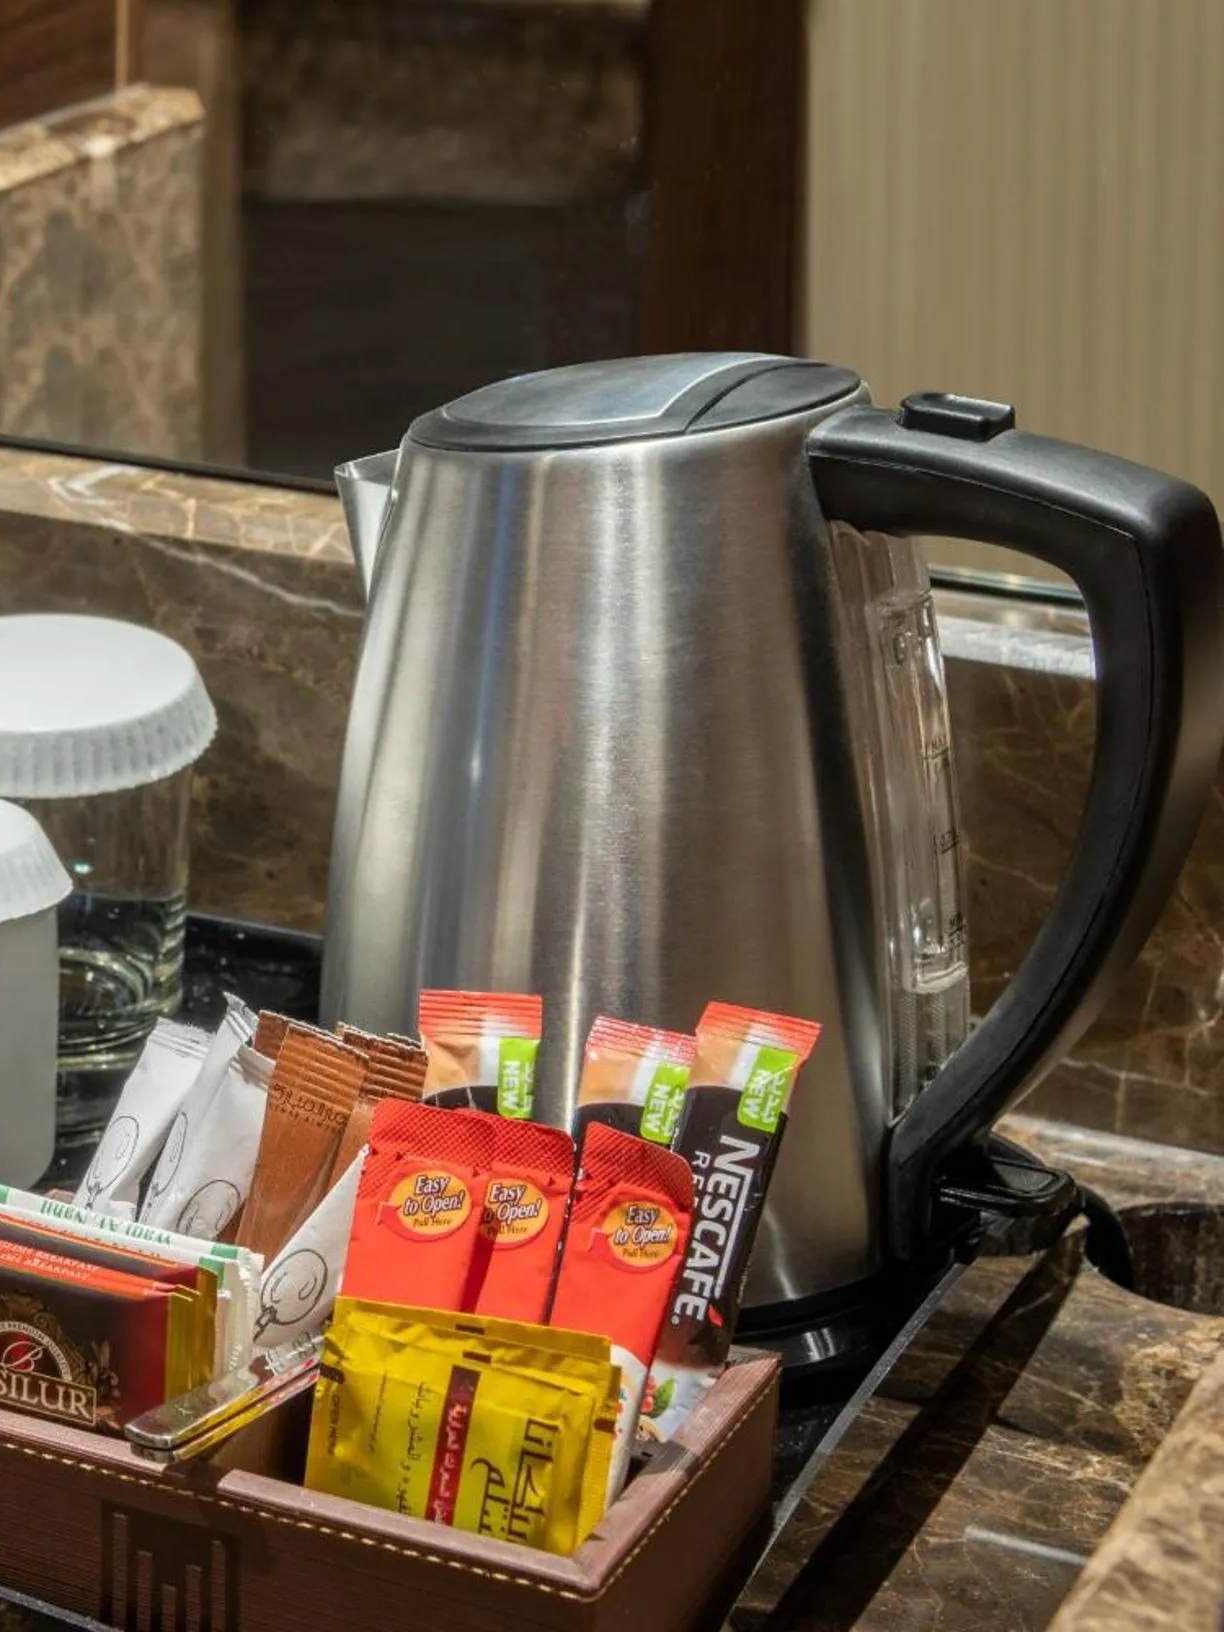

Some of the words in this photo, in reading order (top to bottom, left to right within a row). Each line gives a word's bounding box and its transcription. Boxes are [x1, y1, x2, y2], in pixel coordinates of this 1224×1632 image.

[501, 1060, 521, 1111] NEW
[740, 1069, 770, 1119] NEW
[643, 1083, 670, 1134] NEW
[416, 1175, 450, 1198] Easy
[489, 1183, 526, 1205] Easy
[403, 1199, 418, 1216] to
[421, 1190, 466, 1217] Open!
[497, 1199, 543, 1225] Open!
[625, 1204, 660, 1228] Easy
[614, 1227, 629, 1245] to
[631, 1224, 673, 1249] Open!
